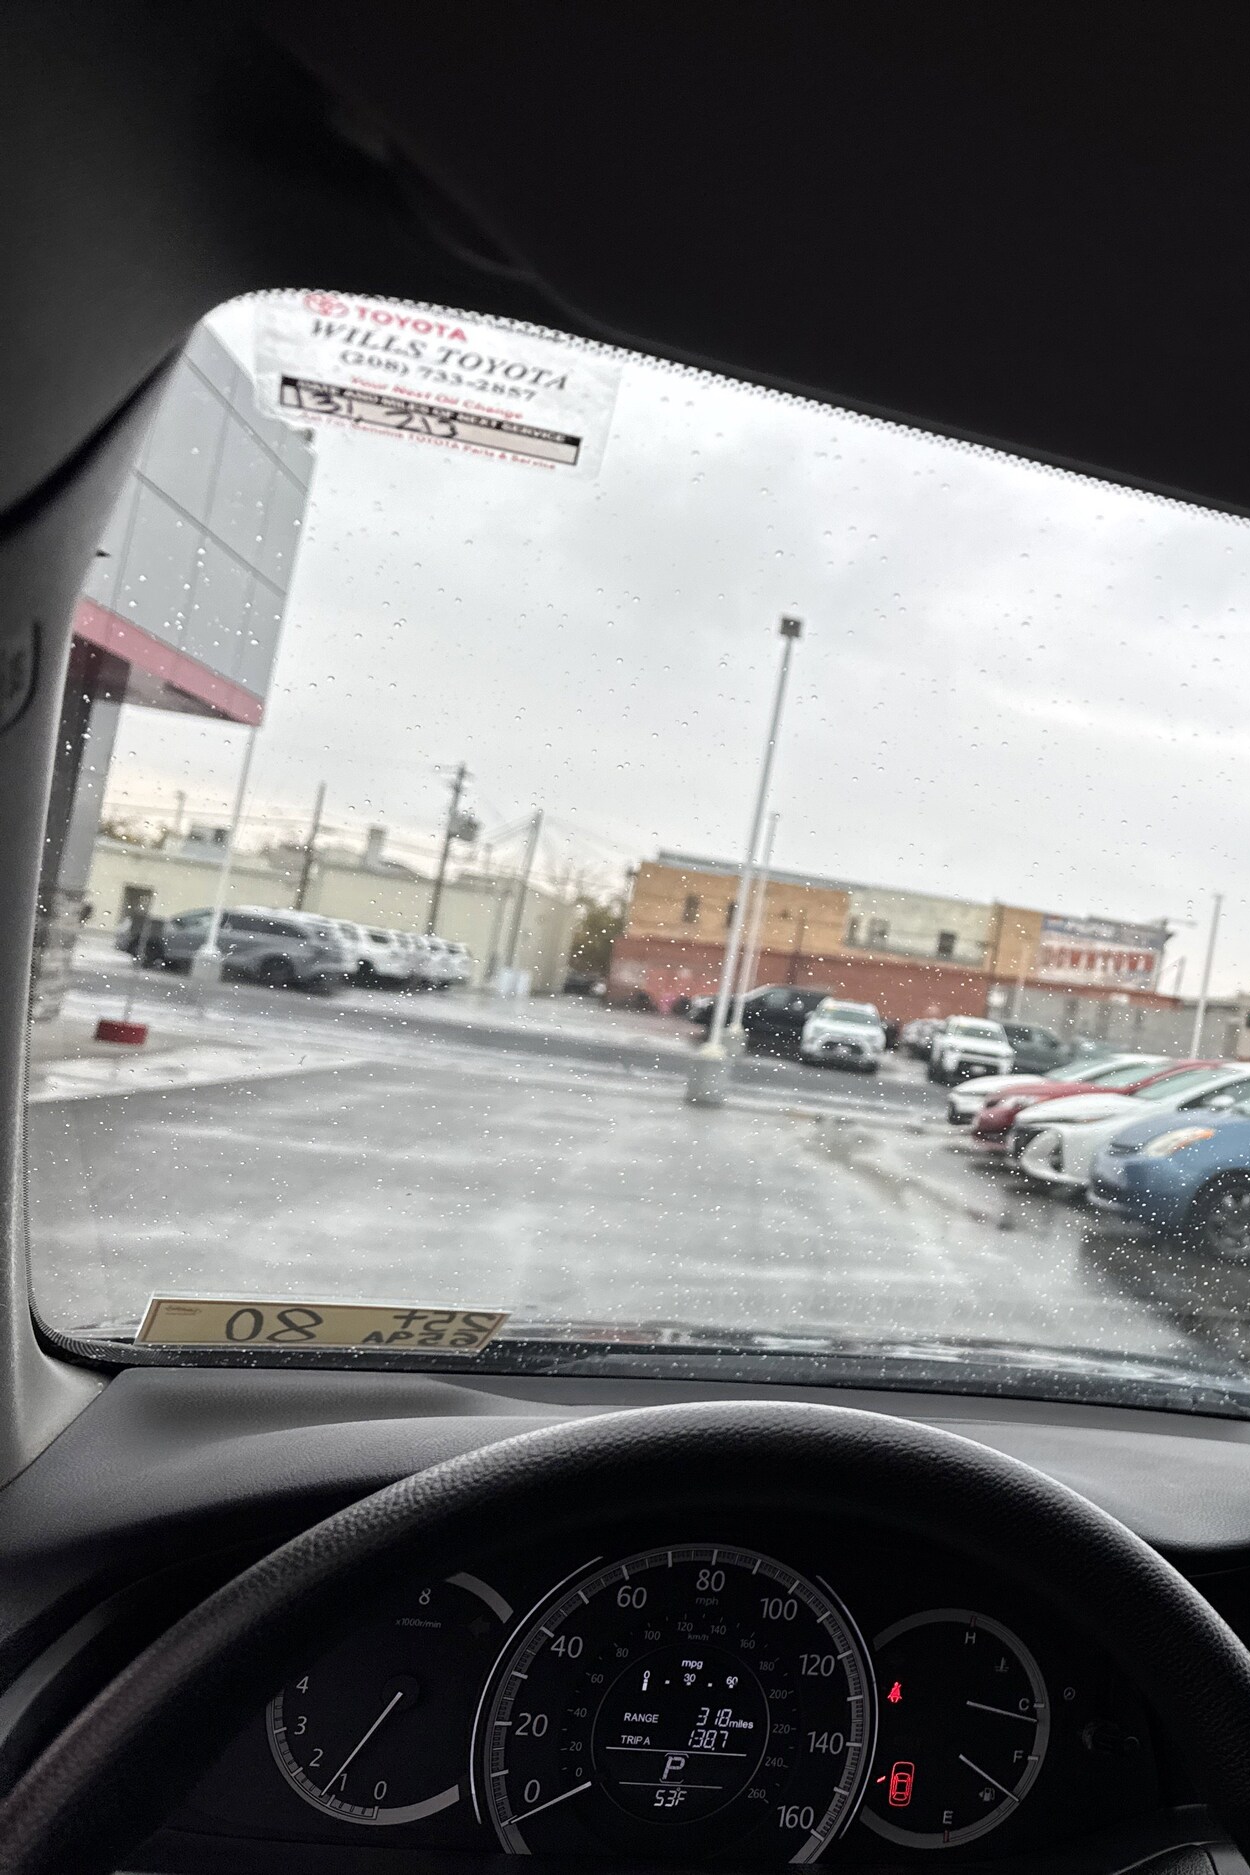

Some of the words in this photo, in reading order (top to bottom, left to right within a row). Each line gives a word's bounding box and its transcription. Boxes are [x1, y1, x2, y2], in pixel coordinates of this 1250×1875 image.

[356, 304, 467, 342] TOYOTA
[312, 318, 428, 359] WILLS
[436, 345, 574, 390] TOYOTA
[462, 398, 524, 420] Change
[695, 1568, 726, 1593] 80
[418, 1587, 432, 1606] 8
[616, 1585, 648, 1609] 60
[695, 1596, 720, 1607] mph
[760, 1597, 799, 1621] 100
[676, 1621, 694, 1632] 120
[710, 1625, 727, 1636] 140
[644, 1630, 661, 1641] 100
[688, 1632, 710, 1642] km/h
[964, 1631, 977, 1645] H
[550, 1635, 584, 1659] 40
[740, 1638, 756, 1650] 160
[615, 1647, 629, 1658] 80
[681, 1659, 704, 1670] mpg
[759, 1660, 775, 1672] 180
[799, 1653, 836, 1678] 120
[296, 1675, 310, 1694] 4
[590, 1673, 604, 1684] 60
[683, 1673, 696, 1683] 30
[726, 1676, 739, 1686] 60
[769, 1688, 788, 1700] 200
[1018, 1697, 1031, 1712] C
[572, 1707, 588, 1718] 40
[624, 1712, 660, 1724] RANGE
[696, 1707, 732, 1728] 318
[728, 1719, 754, 1729] miles
[294, 1715, 308, 1735] 3
[514, 1712, 549, 1738] 20
[772, 1723, 791, 1734] 220
[569, 1741, 583, 1752] 20
[620, 1735, 643, 1745] TRIP
[807, 1730, 845, 1755] 140
[309, 1748, 324, 1767] 2
[765, 1756, 784, 1767] 240
[1012, 1750, 1024, 1764] F
[575, 1767, 584, 1778] 0
[661, 1755, 686, 1780] P
[338, 1772, 348, 1792] 1
[373, 1780, 388, 1800] 0
[523, 1778, 542, 1804] 0
[748, 1788, 766, 1799] 260
[776, 1805, 815, 1830] 160
[942, 1810, 954, 1825] E
